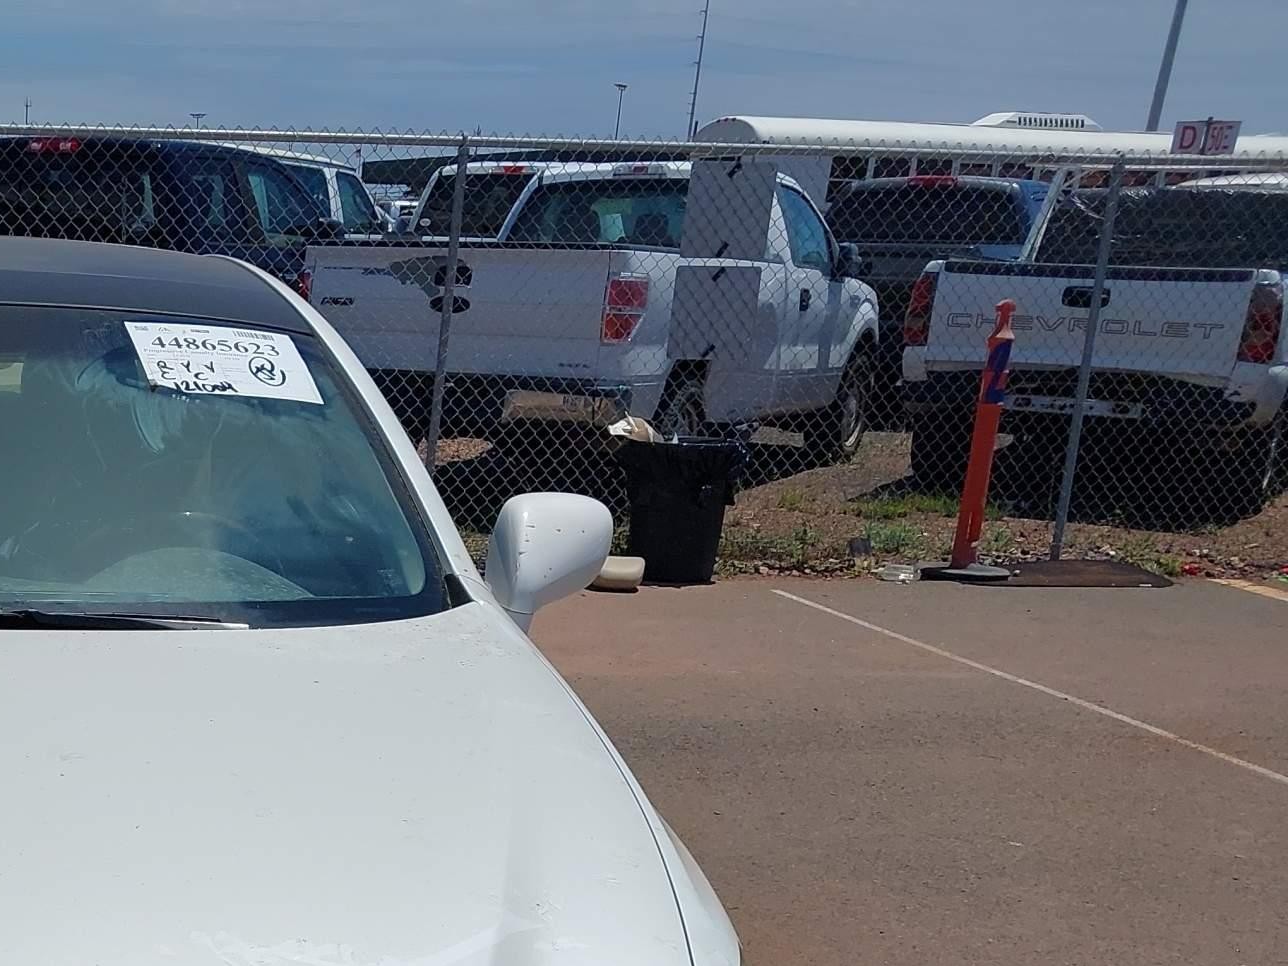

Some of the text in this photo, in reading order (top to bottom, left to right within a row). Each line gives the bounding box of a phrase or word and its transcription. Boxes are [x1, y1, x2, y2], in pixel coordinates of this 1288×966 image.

[1178, 125, 1196, 149] D
[946, 312, 1225, 340] CHEVROLET
[151, 335, 280, 357] 44865623
